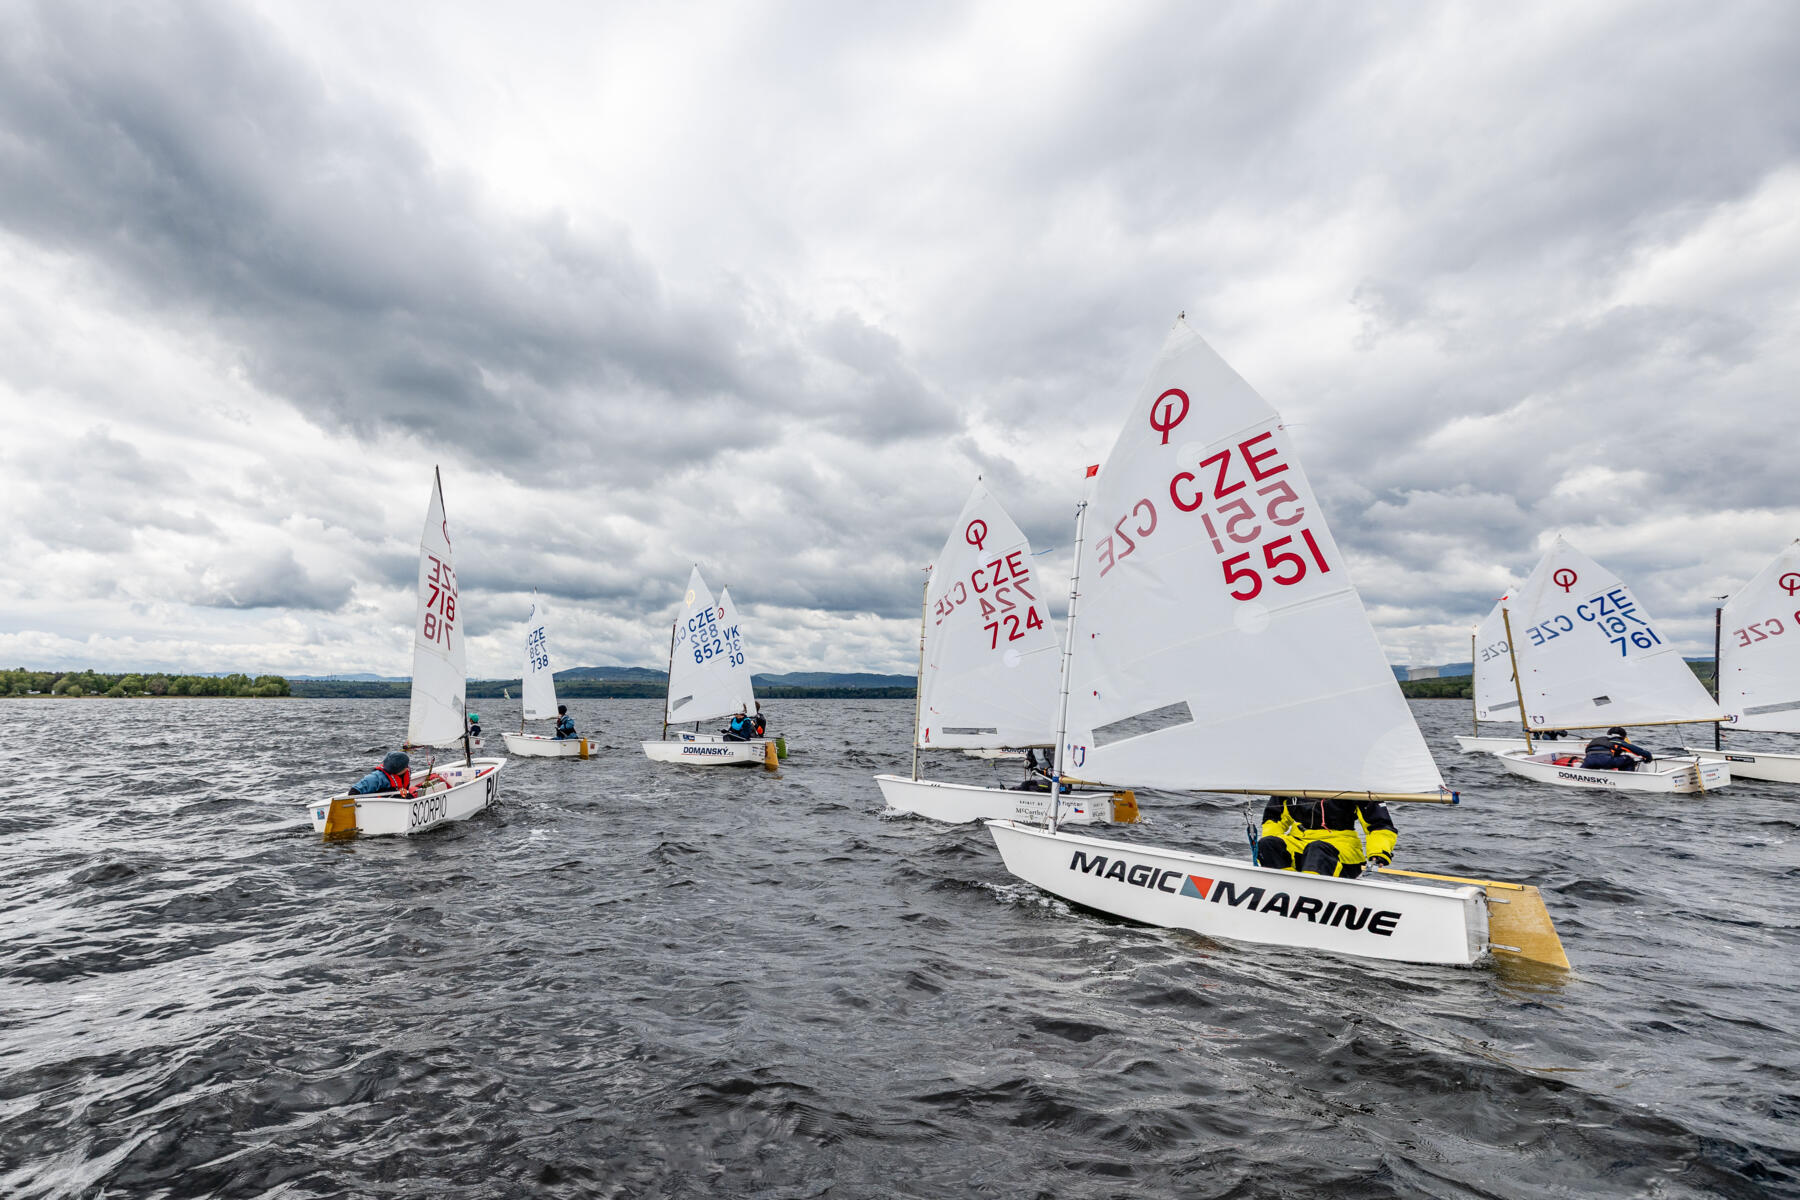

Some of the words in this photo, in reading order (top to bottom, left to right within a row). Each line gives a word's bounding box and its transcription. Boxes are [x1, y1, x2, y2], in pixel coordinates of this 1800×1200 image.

[1170, 431, 1289, 512] CZE
[971, 550, 1029, 593] CZE
[1222, 528, 1330, 601] 551
[427, 583, 455, 622] 718
[1576, 589, 1633, 622] CZE
[528, 626, 546, 646] CZE
[688, 607, 716, 632] CZE
[983, 605, 1044, 650] 724
[694, 639, 724, 664] 852
[1610, 628, 1662, 657] 761
[531, 654, 549, 673] 738
[729, 652, 744, 667] 30
[411, 794, 447, 827] SCORPIO
[1069, 851, 1184, 894] MAGIC
[1210, 881, 1402, 936] MARINE
